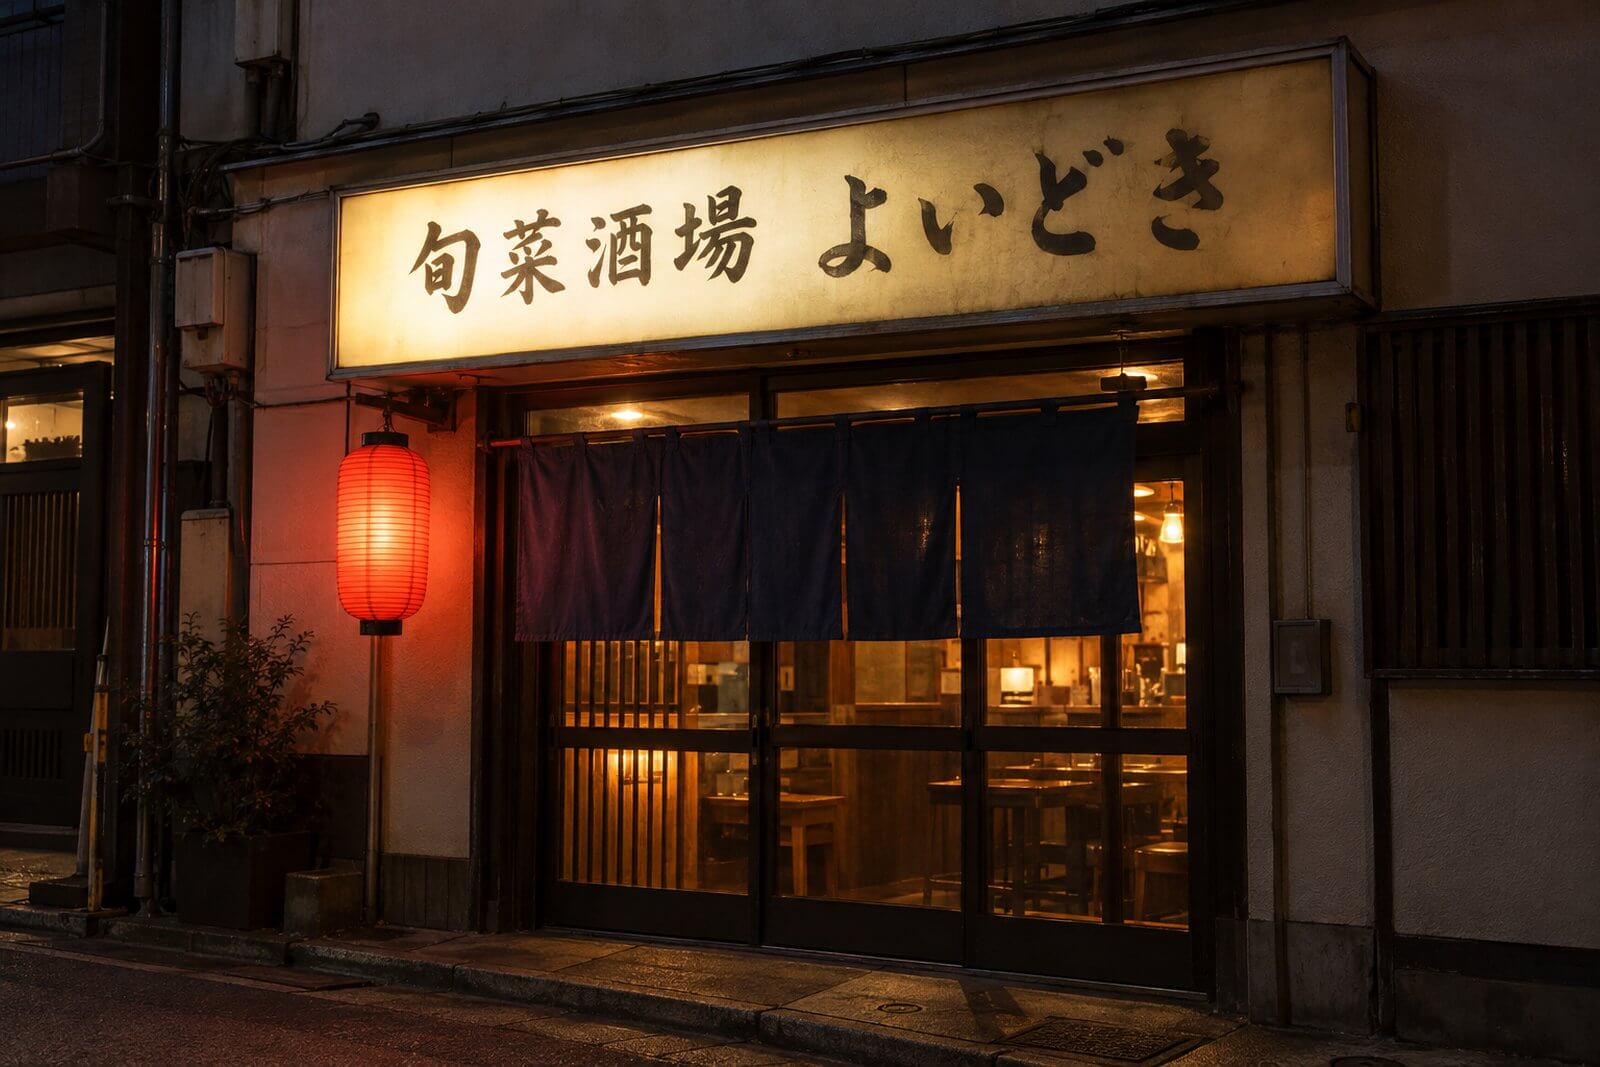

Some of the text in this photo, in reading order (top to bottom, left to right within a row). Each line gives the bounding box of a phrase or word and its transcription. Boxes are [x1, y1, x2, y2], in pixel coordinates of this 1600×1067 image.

[409, 127, 1225, 314] 旬菜酒場 よいどき
